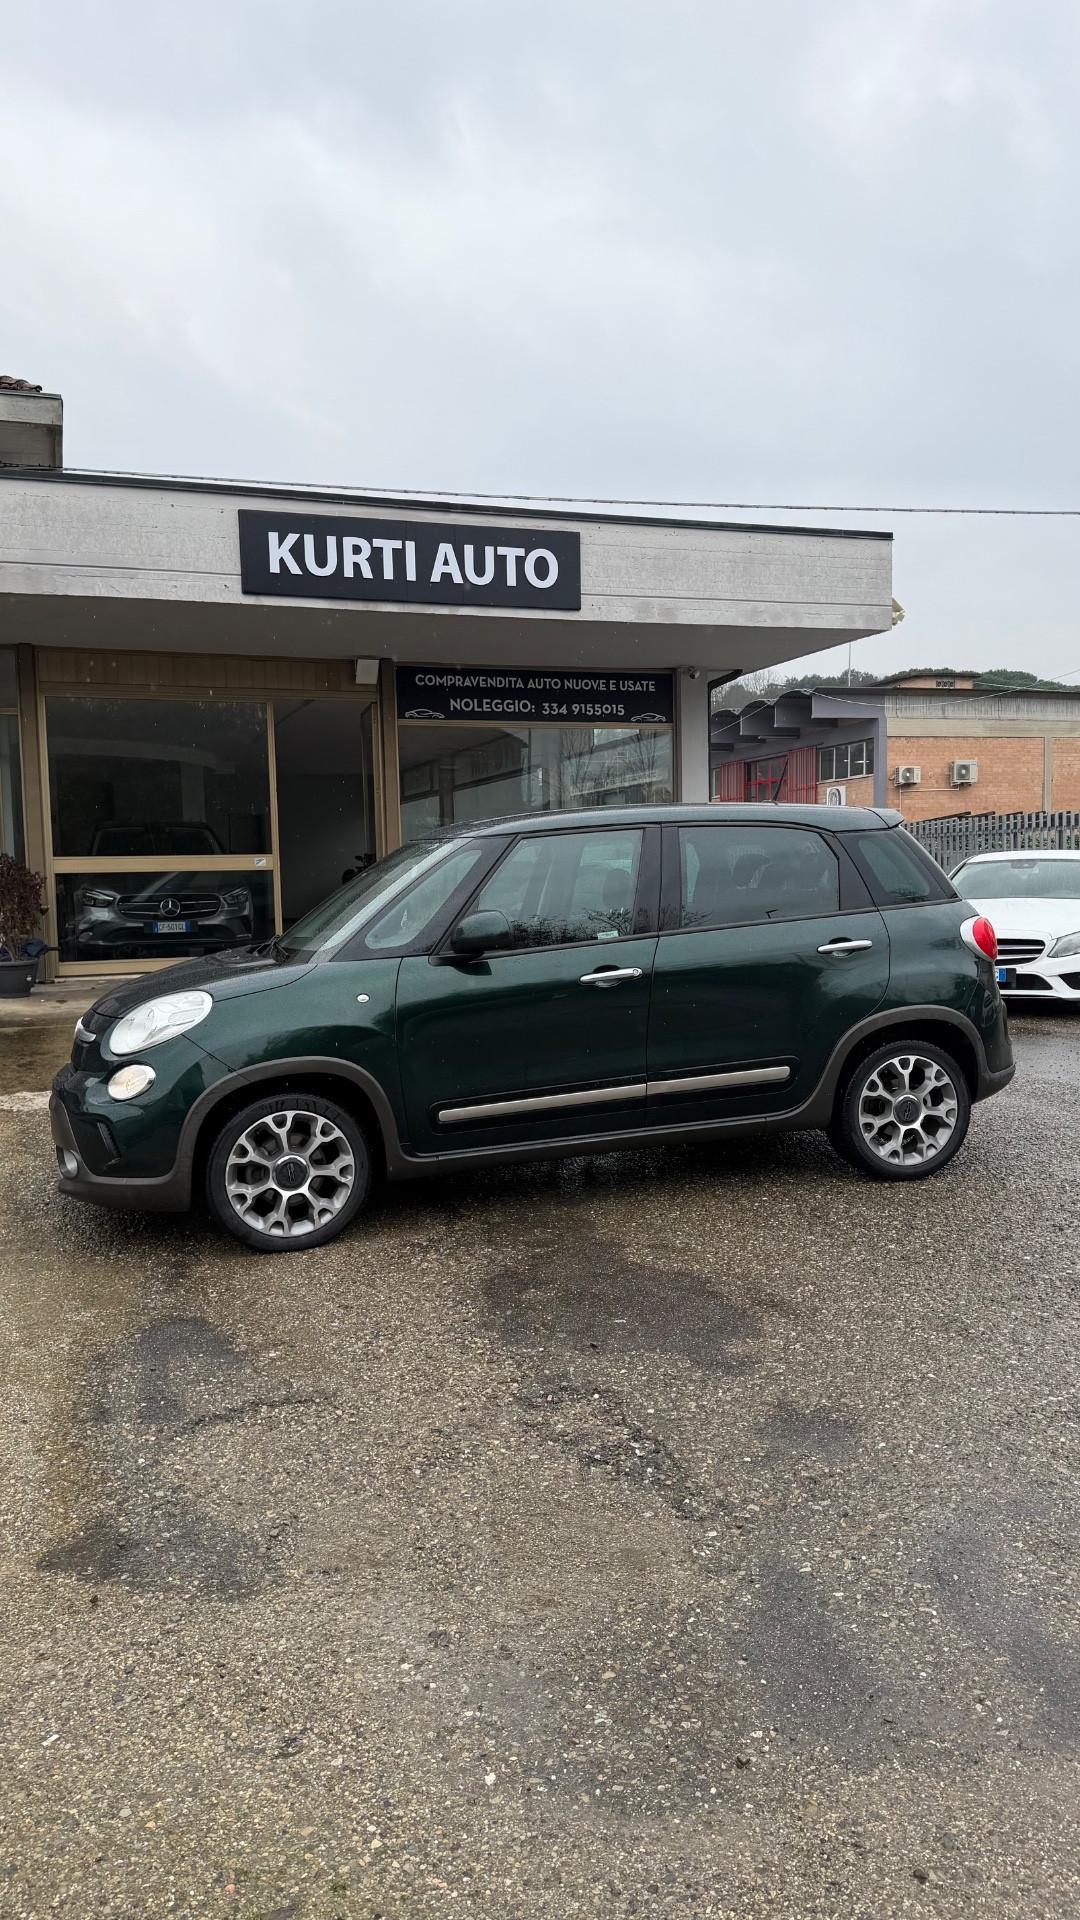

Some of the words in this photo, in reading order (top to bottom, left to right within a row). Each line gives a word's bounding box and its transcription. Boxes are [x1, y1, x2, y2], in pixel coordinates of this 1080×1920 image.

[268, 532, 417, 581] KURTI
[430, 542, 559, 589] AUTO
[415, 674, 524, 688] COMPRAVENDITA
[527, 678, 561, 689] AUTO
[564, 680, 606, 690] NUOVE
[610, 680, 617, 691] E
[620, 680, 656, 692] USATE
[450, 698, 535, 712] NOLEGGIO:
[542, 703, 568, 715] 334
[572, 703, 625, 715] 9155015
